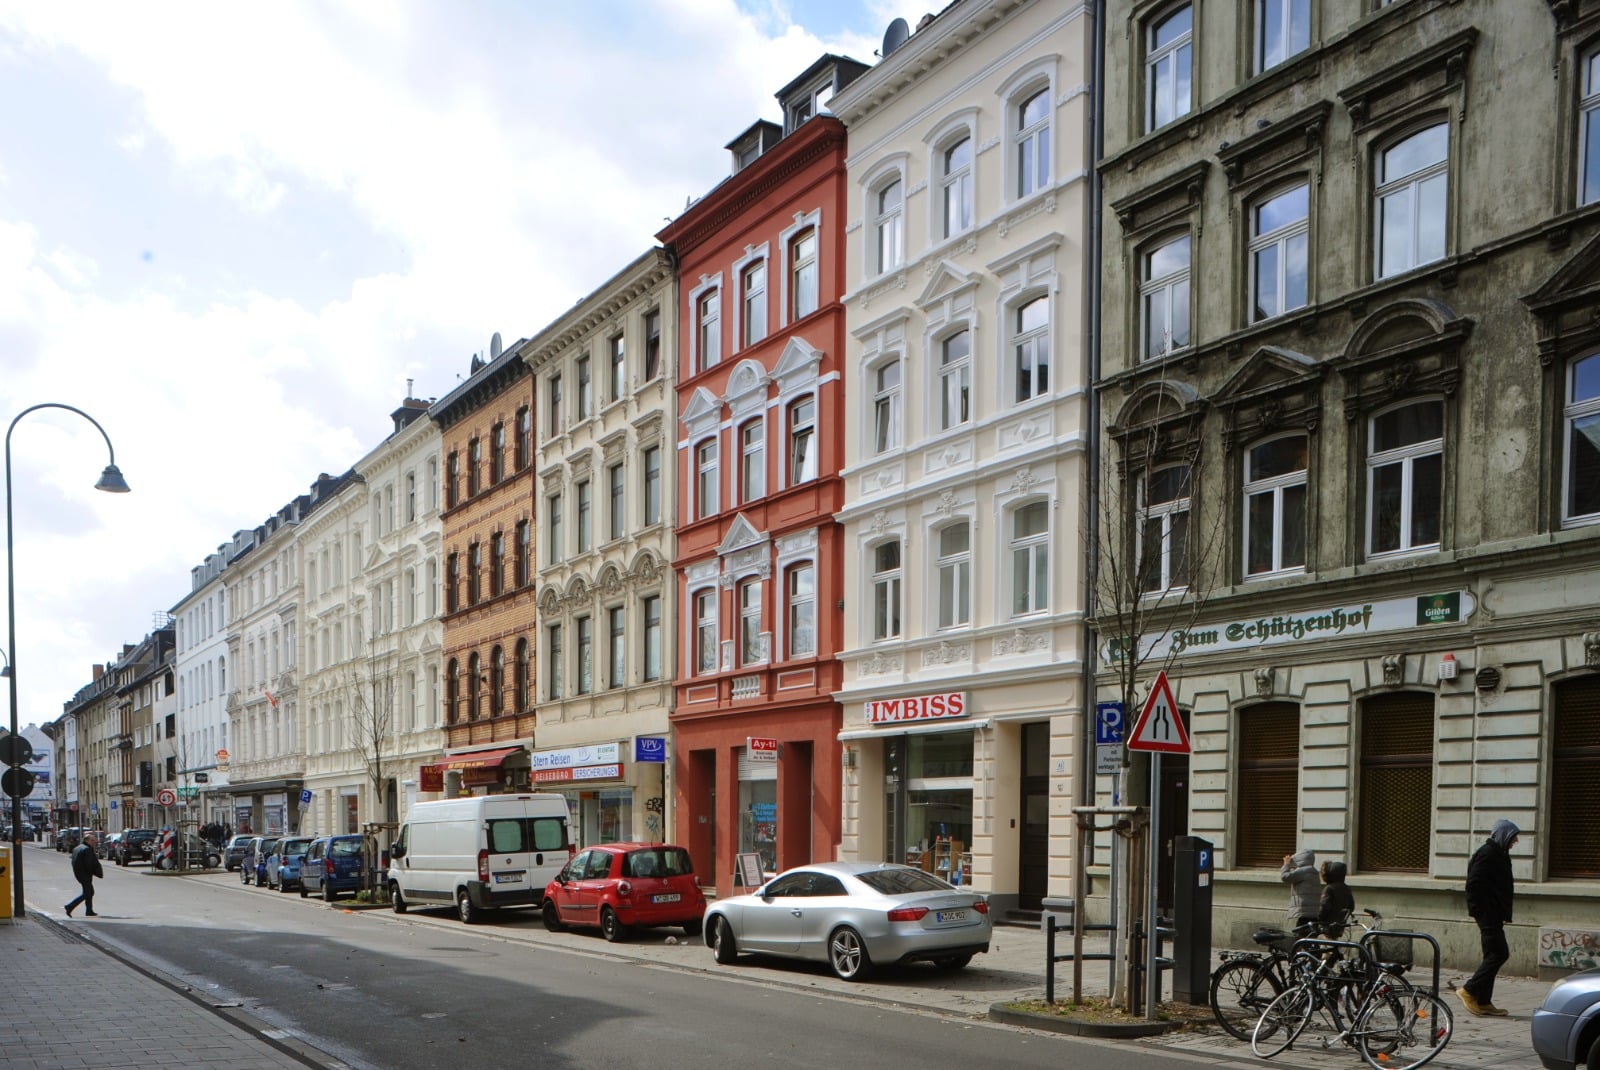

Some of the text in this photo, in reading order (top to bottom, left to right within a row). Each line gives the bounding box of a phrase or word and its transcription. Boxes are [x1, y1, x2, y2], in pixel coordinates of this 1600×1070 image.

[1425, 607, 1451, 617] Gilden
[1169, 604, 1373, 653] Zum Schützenhof
[871, 693, 963, 722] IMBISS
[641, 739, 658, 749] VPV
[753, 739, 776, 749] Ay-ti
[533, 754, 549, 768] Stern
[550, 753, 571, 765] Reisen
